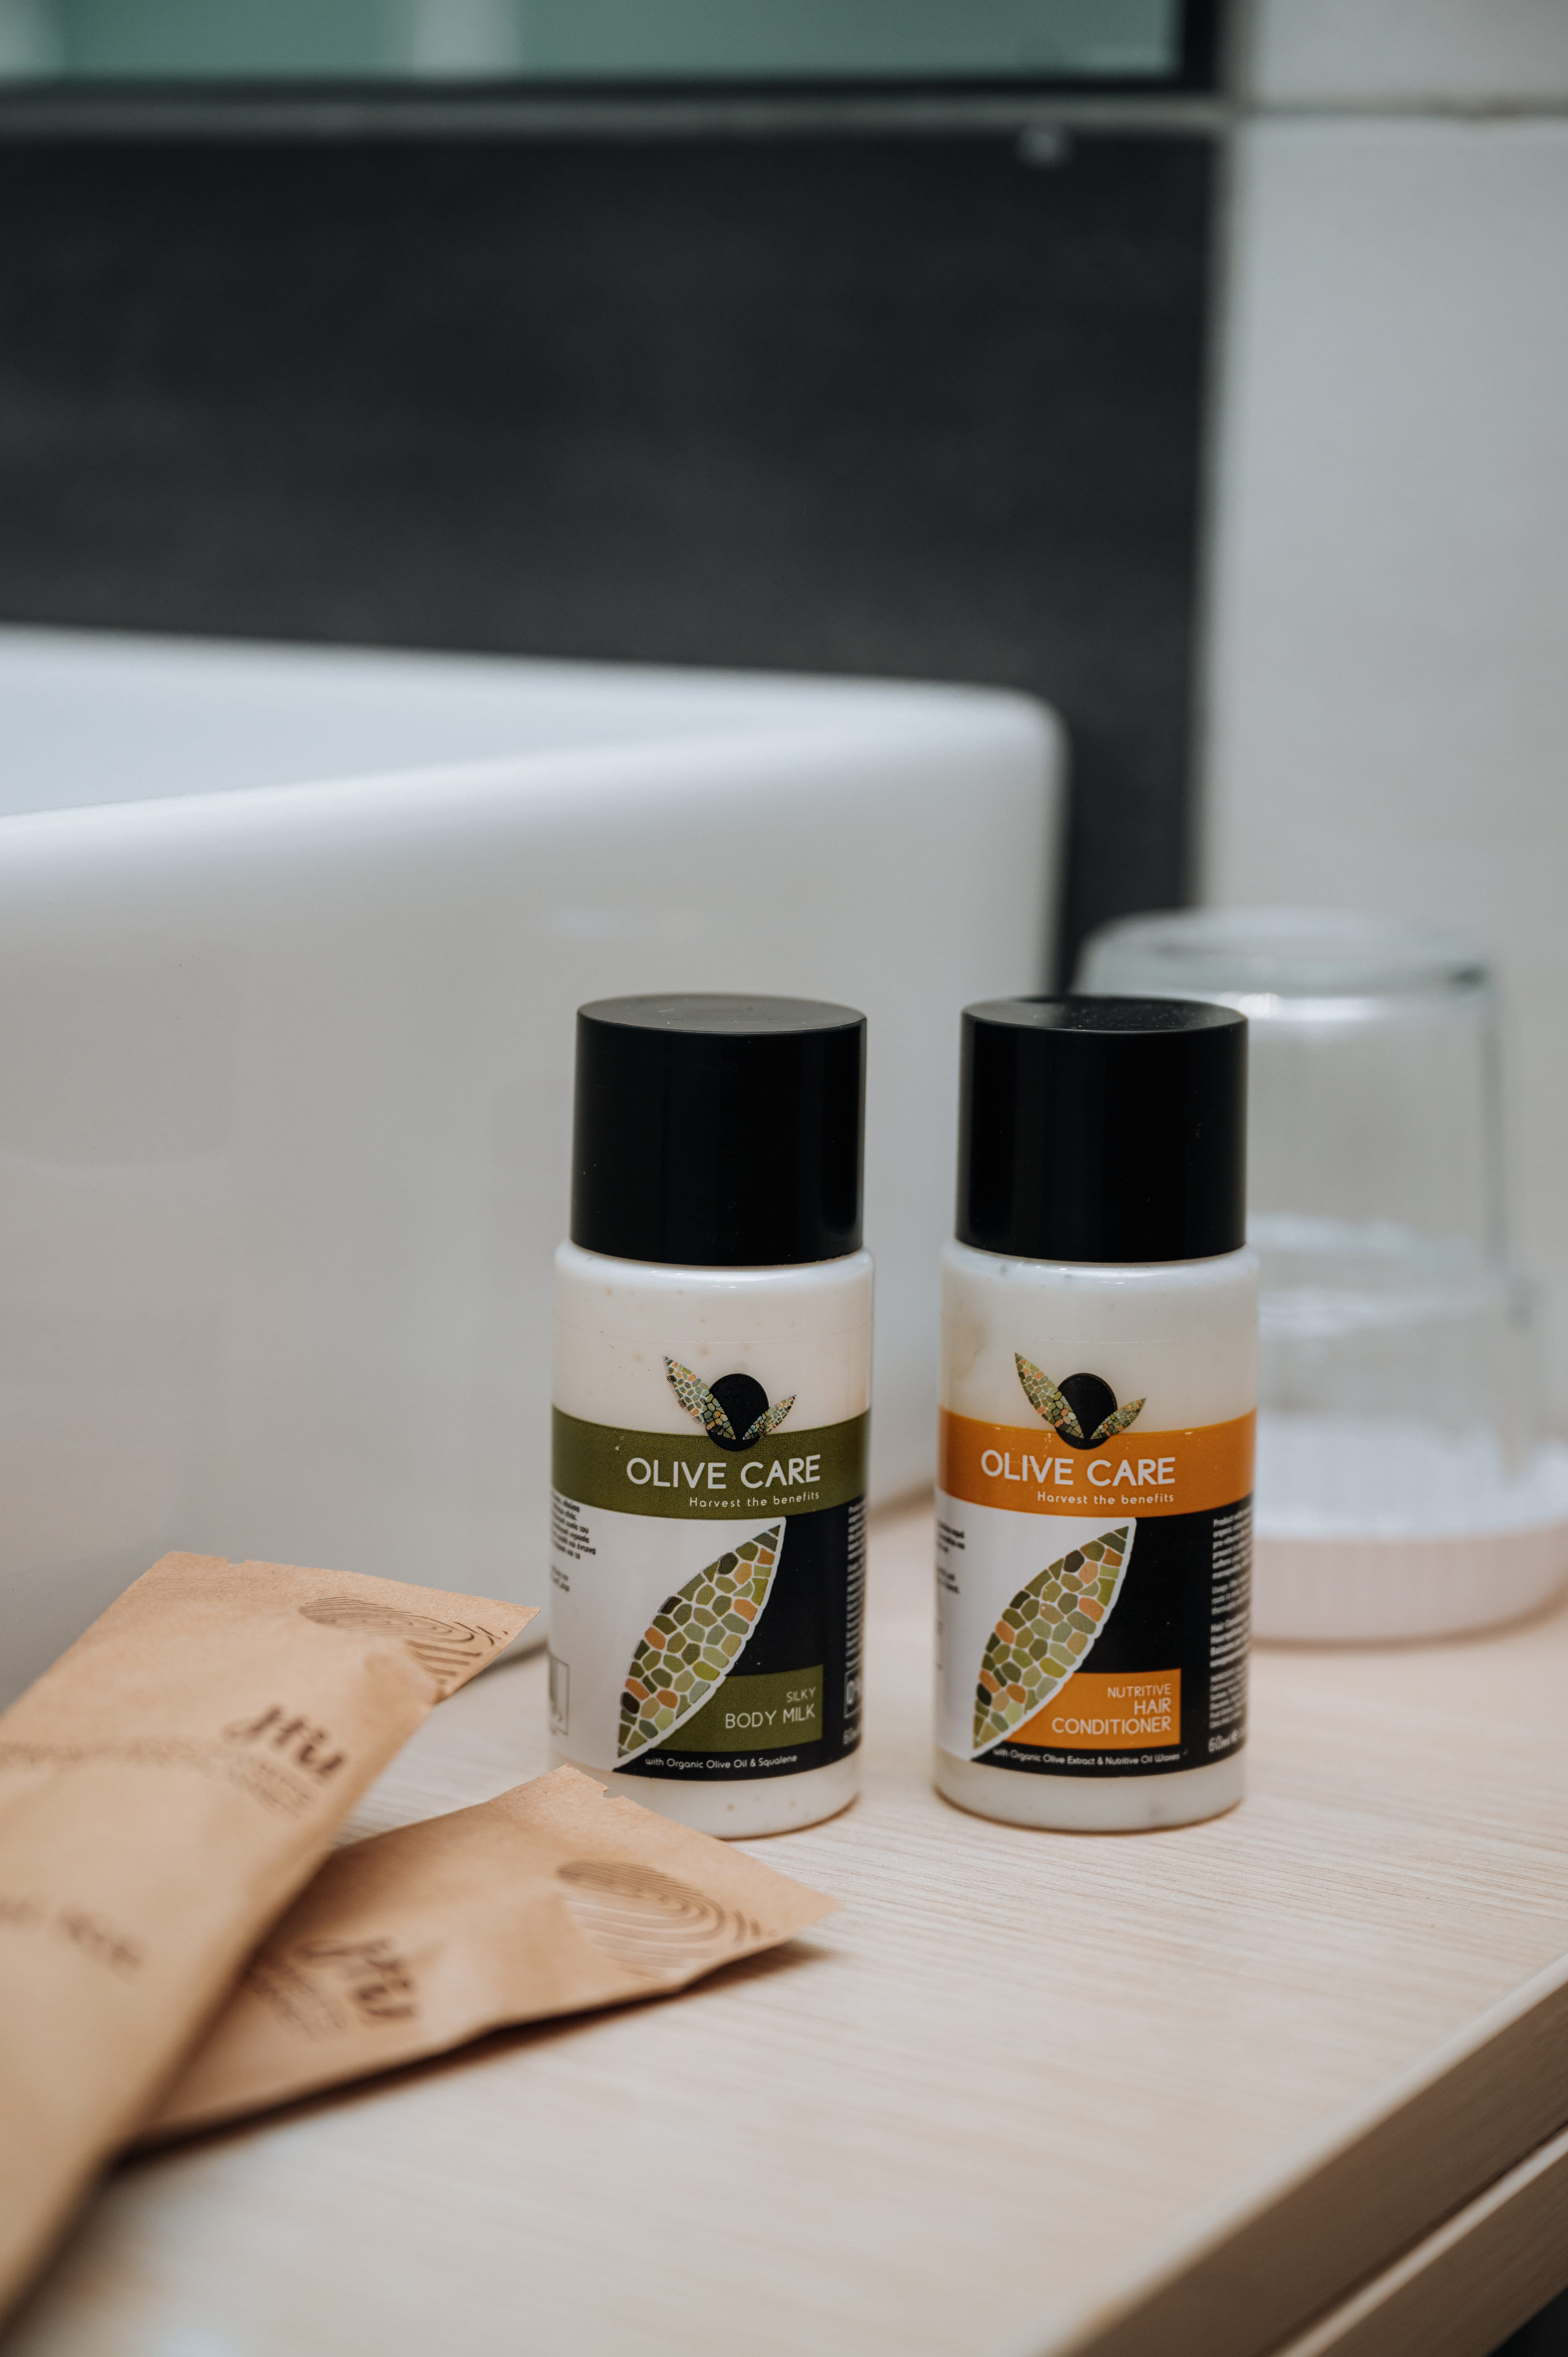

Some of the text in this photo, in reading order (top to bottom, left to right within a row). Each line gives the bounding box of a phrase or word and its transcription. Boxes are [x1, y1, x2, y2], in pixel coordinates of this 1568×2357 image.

[626, 1454, 821, 1489] OLIVE CARE
[981, 1449, 1175, 1486] OLIVE CARE
[690, 1491, 820, 1508] Harvest the benefits
[1037, 1491, 1174, 1505] Harvest the benefits
[786, 1686, 816, 1702] SILKY
[1107, 1684, 1171, 1698] NUTRITIVE
[1134, 1698, 1171, 1715] HAIR
[725, 1703, 816, 1728] BODY MILK
[1051, 1716, 1171, 1734] CONDITIONER
[645, 1755, 797, 1770] with Organic Olive Oil & Squalene
[992, 1748, 1181, 1766] with Organic Olive Extract & Nutritive Oil Waxes
